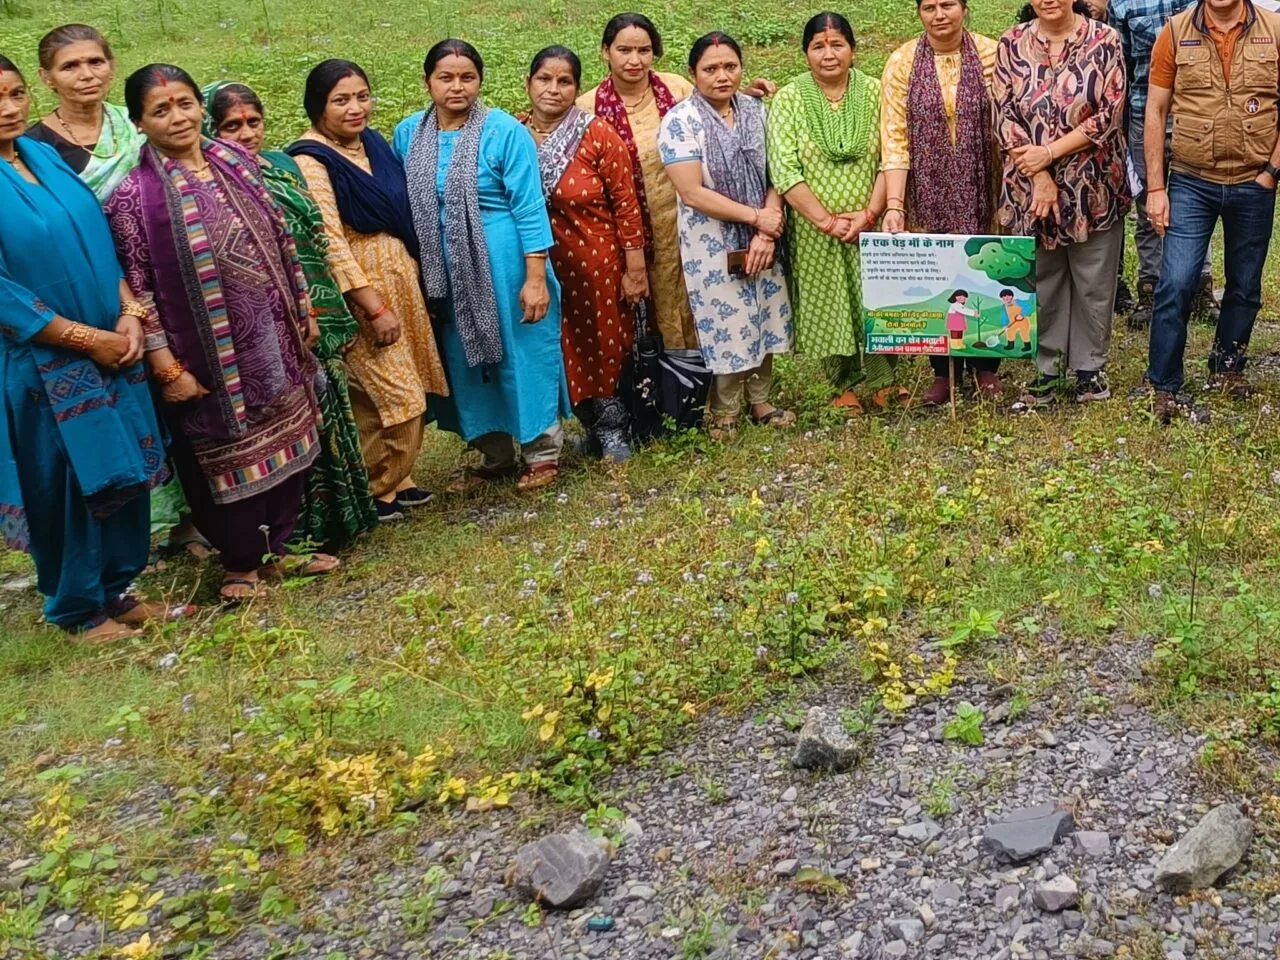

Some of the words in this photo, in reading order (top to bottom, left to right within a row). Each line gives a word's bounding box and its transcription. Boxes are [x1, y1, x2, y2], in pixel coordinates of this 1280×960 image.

[861, 238, 869, 247] #
[873, 238, 889, 247] एक
[892, 238, 905, 250] पेड़
[923, 238, 932, 247] के
[872, 335, 893, 343] भवाली
